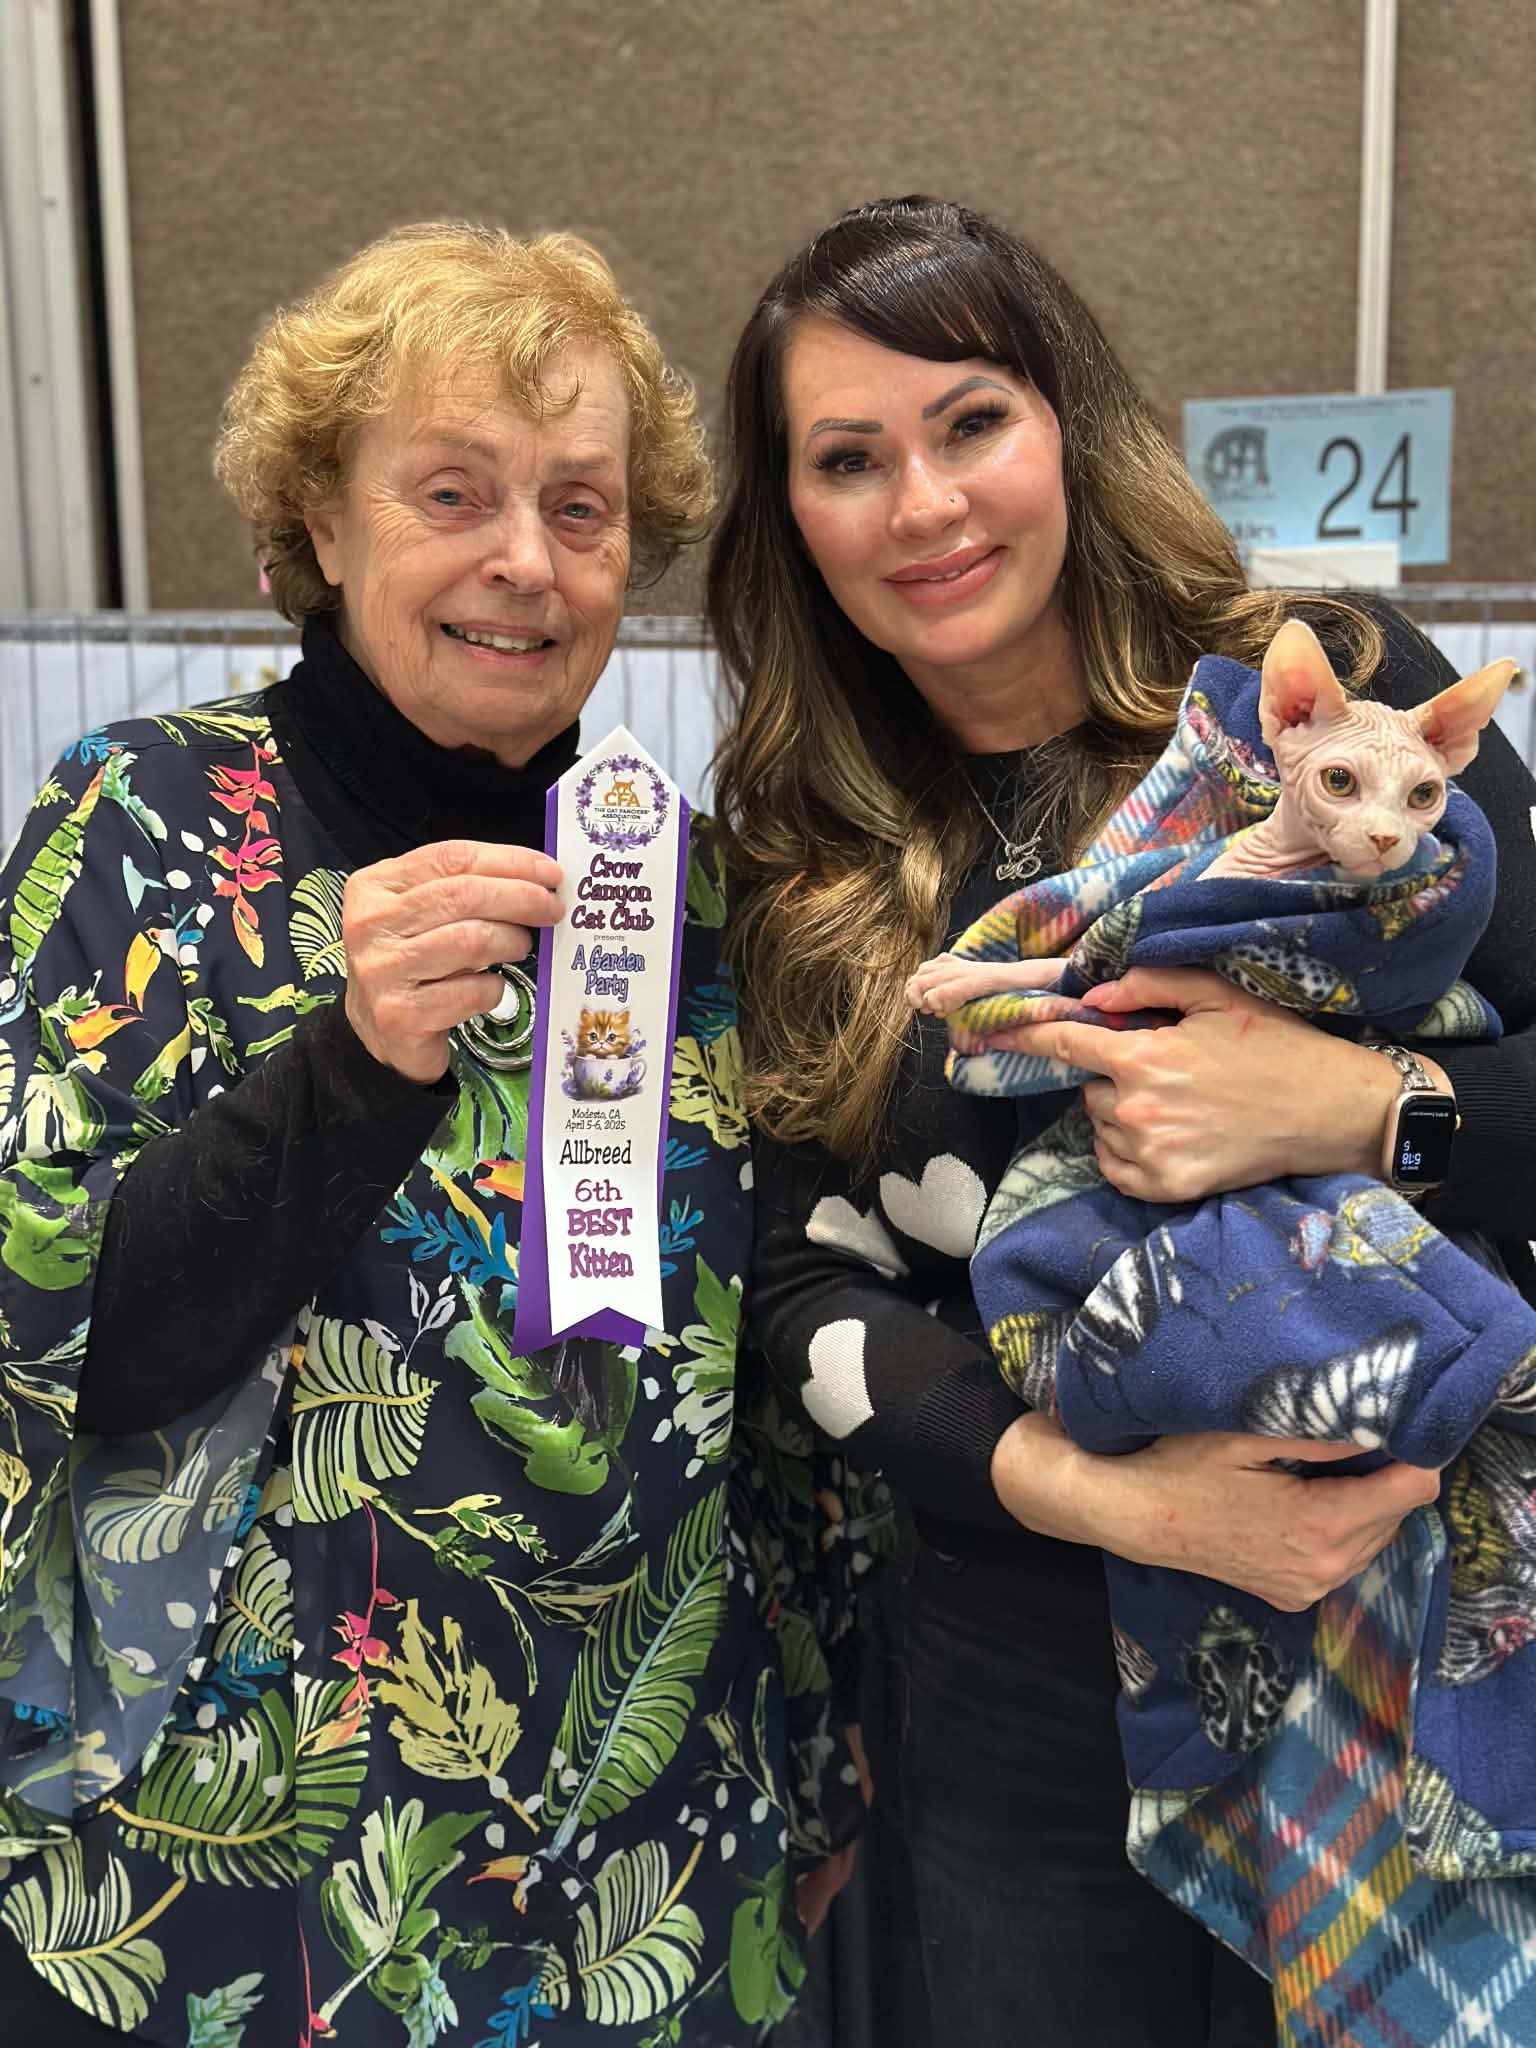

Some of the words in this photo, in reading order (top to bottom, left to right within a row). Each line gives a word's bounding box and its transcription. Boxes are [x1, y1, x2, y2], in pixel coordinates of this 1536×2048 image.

[1316, 432, 1419, 539] 24
[603, 791, 641, 806] CFA
[590, 853, 644, 879] Crow
[577, 877, 653, 905] Canyon
[571, 905, 606, 930] Cat
[610, 904, 655, 931] Club
[593, 933, 625, 942] presents
[571, 945, 587, 970] A
[589, 945, 646, 971] Garden
[585, 970, 630, 1003] Party
[565, 1120, 585, 1132] April
[586, 1120, 602, 1131] 5-6,
[604, 1120, 626, 1130] 2025
[572, 1108, 607, 1119] Modesto,
[608, 1108, 621, 1119] CA
[559, 1139, 633, 1166] Allbreed
[575, 1178, 623, 1202] 6th
[567, 1207, 633, 1237] BEST
[569, 1243, 634, 1279] Kitten
